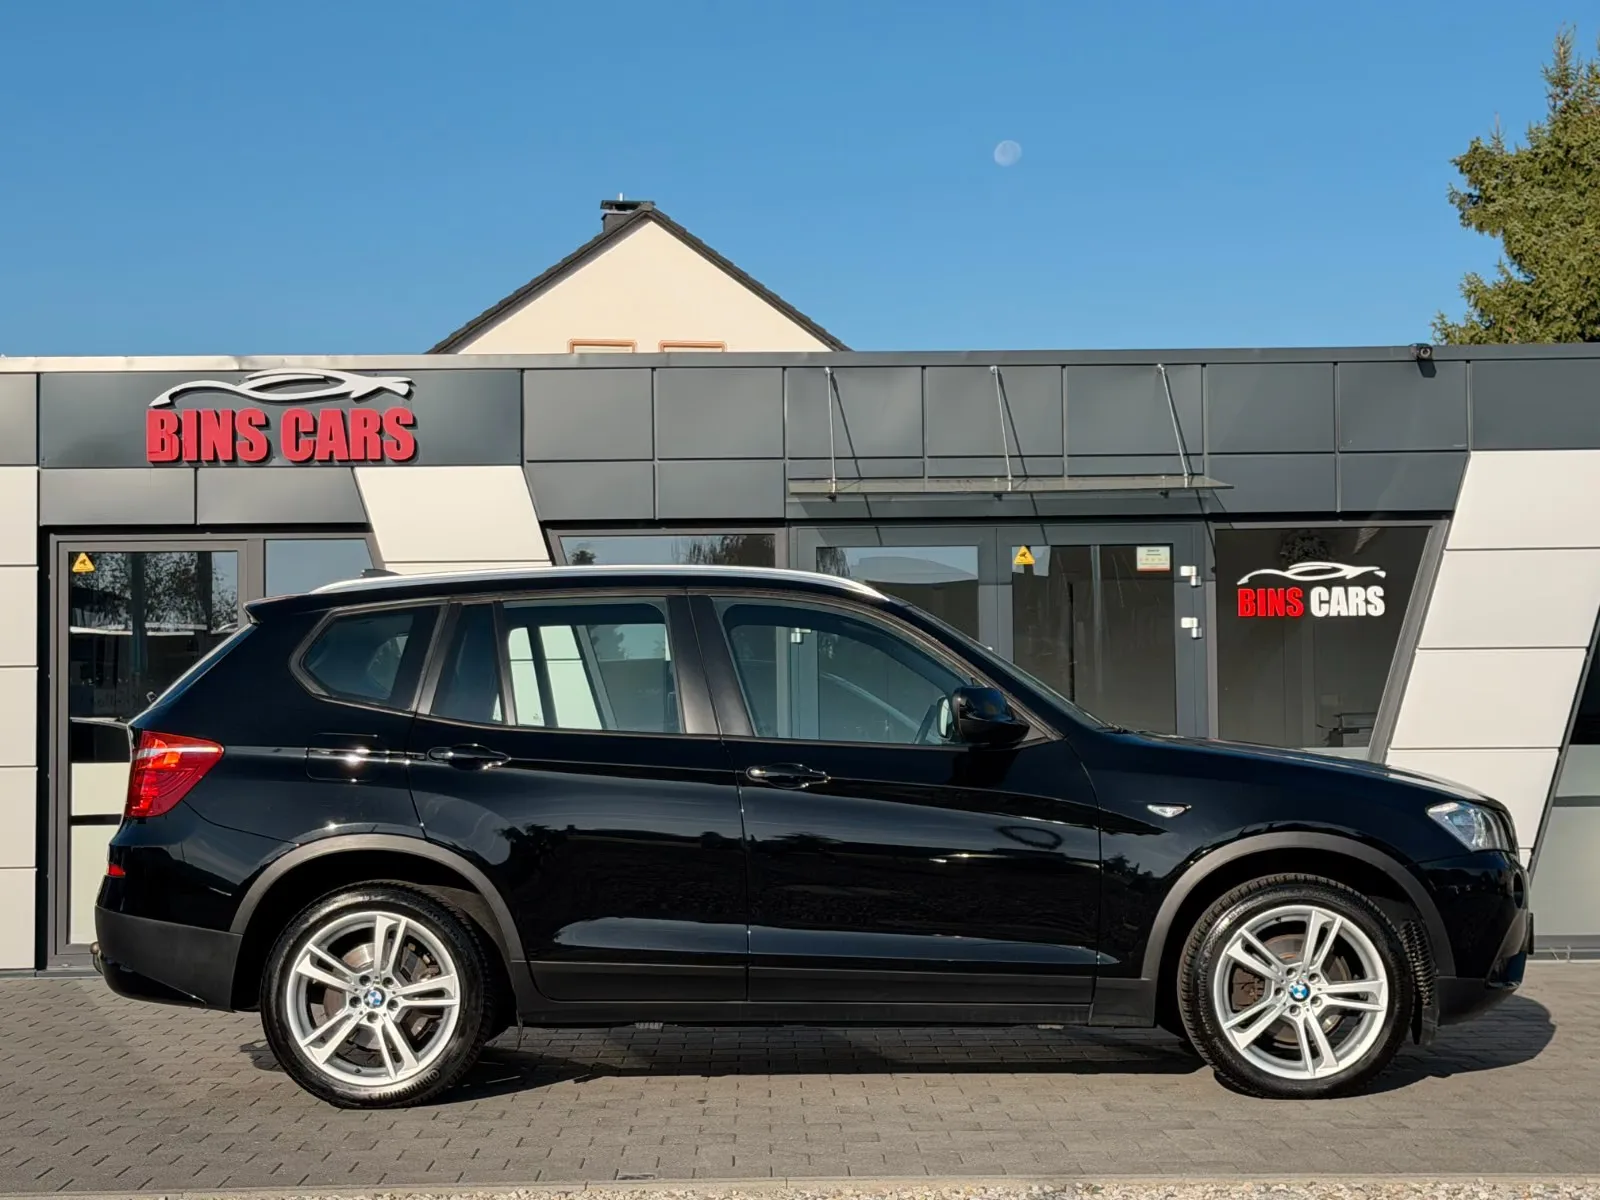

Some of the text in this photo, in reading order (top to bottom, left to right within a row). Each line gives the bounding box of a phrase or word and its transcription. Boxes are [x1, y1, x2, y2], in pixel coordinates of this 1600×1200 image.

[146, 407, 416, 463] BINS CARS
[1237, 585, 1386, 617] BINS CARS
